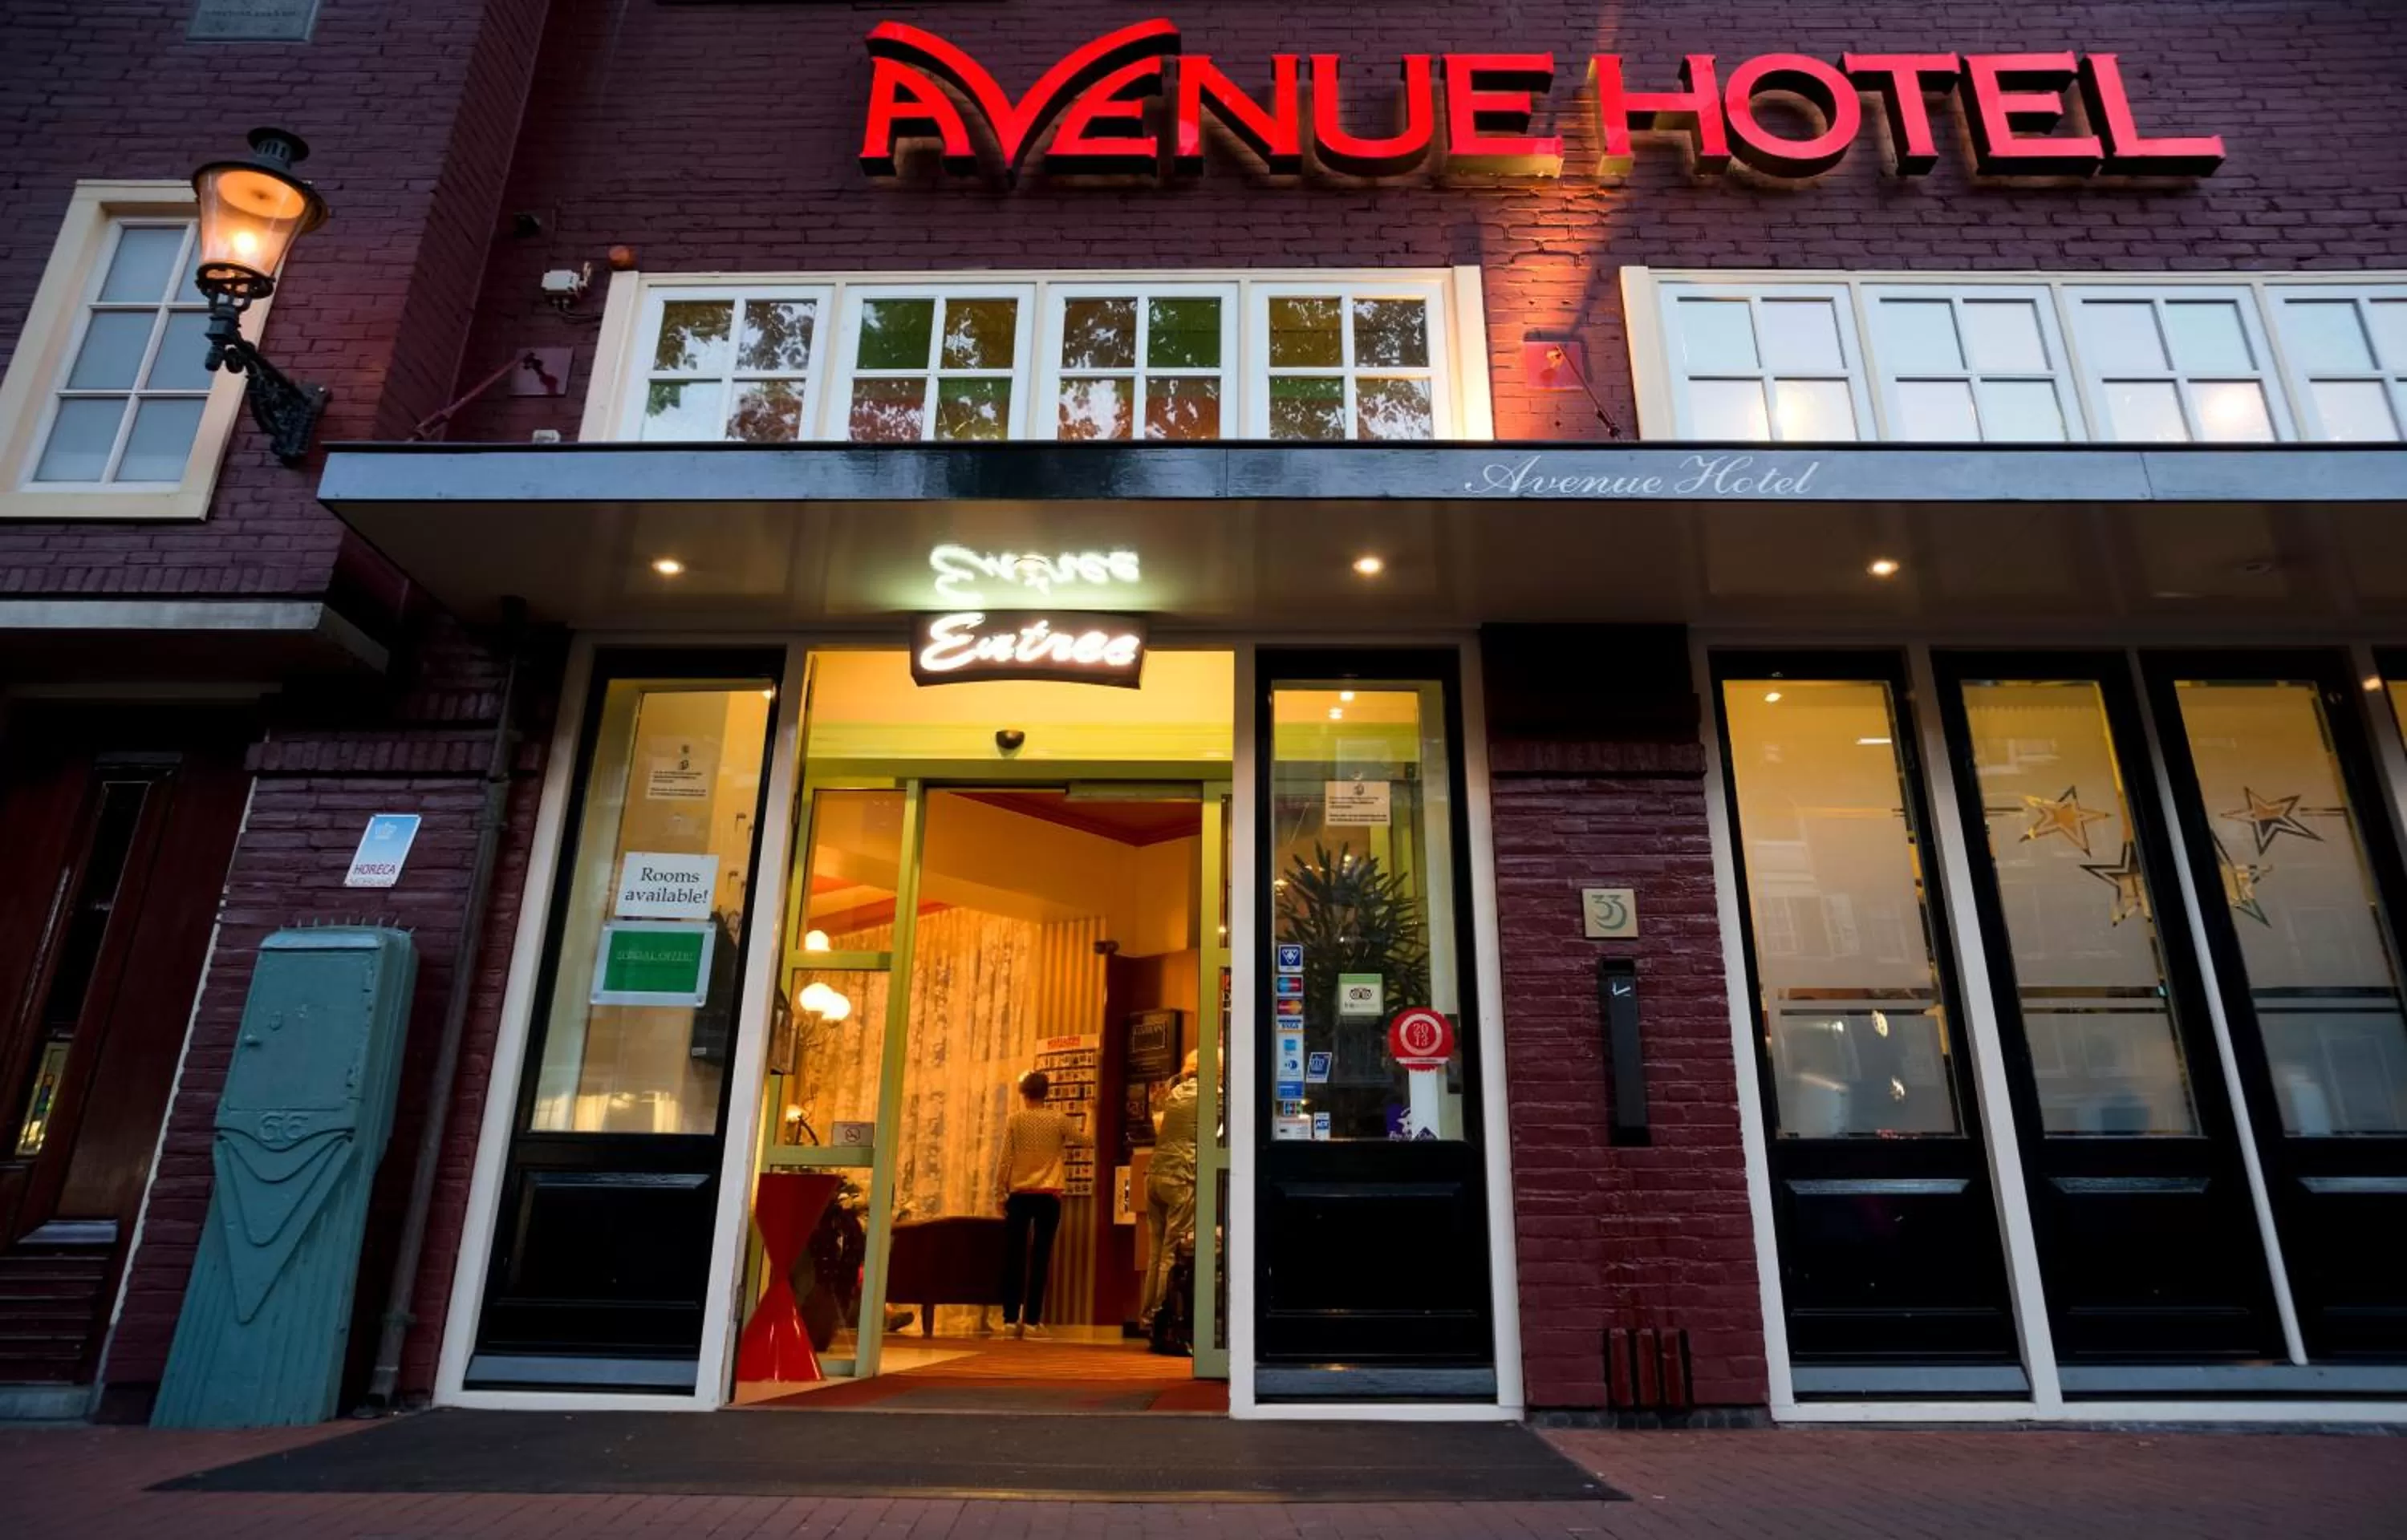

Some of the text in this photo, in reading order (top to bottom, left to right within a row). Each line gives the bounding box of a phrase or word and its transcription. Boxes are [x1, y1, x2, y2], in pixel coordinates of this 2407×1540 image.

[860, 18, 2225, 176] AVENUE HOTEL
[1464, 454, 1820, 495] Avenue Hotel
[920, 612, 1141, 671] Entree
[353, 864, 396, 875] HORECA
[640, 866, 700, 883] Rooms
[624, 886, 709, 904] available!
[1591, 894, 1627, 930] 33
[1413, 1023, 1429, 1035] 20
